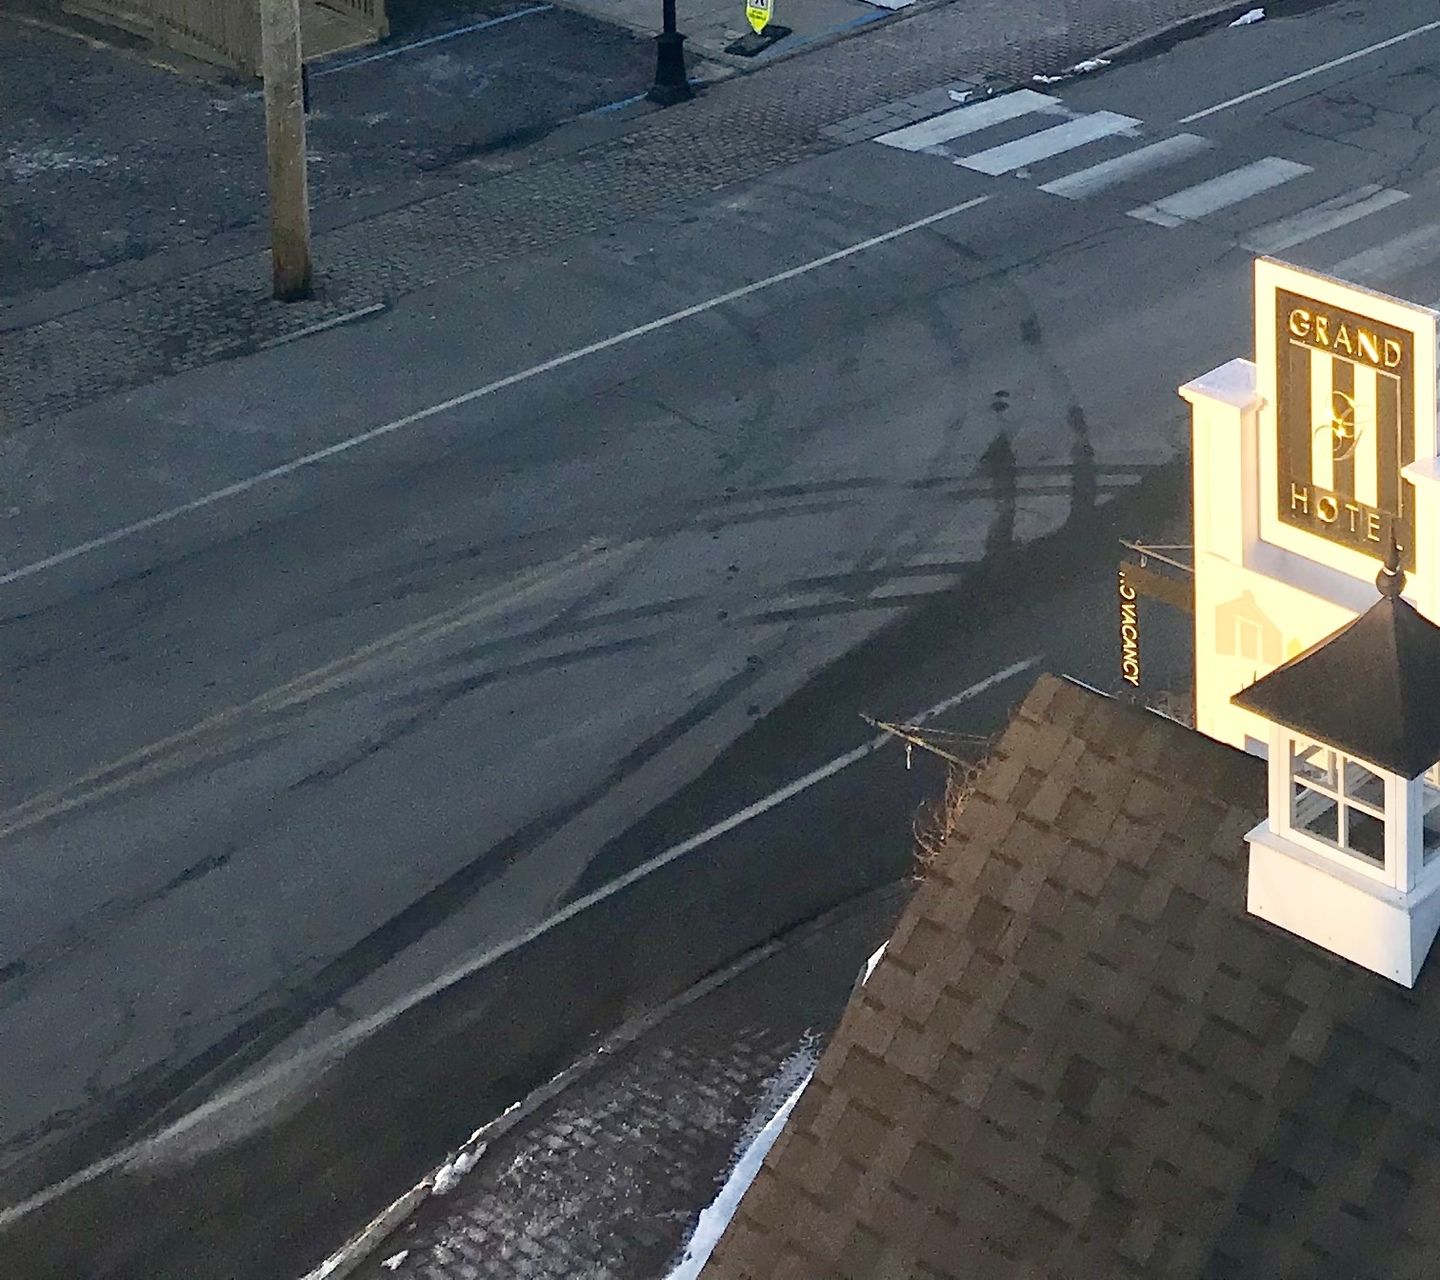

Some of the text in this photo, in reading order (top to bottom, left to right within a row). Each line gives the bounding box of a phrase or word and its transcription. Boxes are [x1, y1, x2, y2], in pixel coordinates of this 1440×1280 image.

[1289, 308, 1401, 368] GRAND
[1291, 482, 1404, 551] HOTE
[1121, 603, 1140, 688] VACANCY
